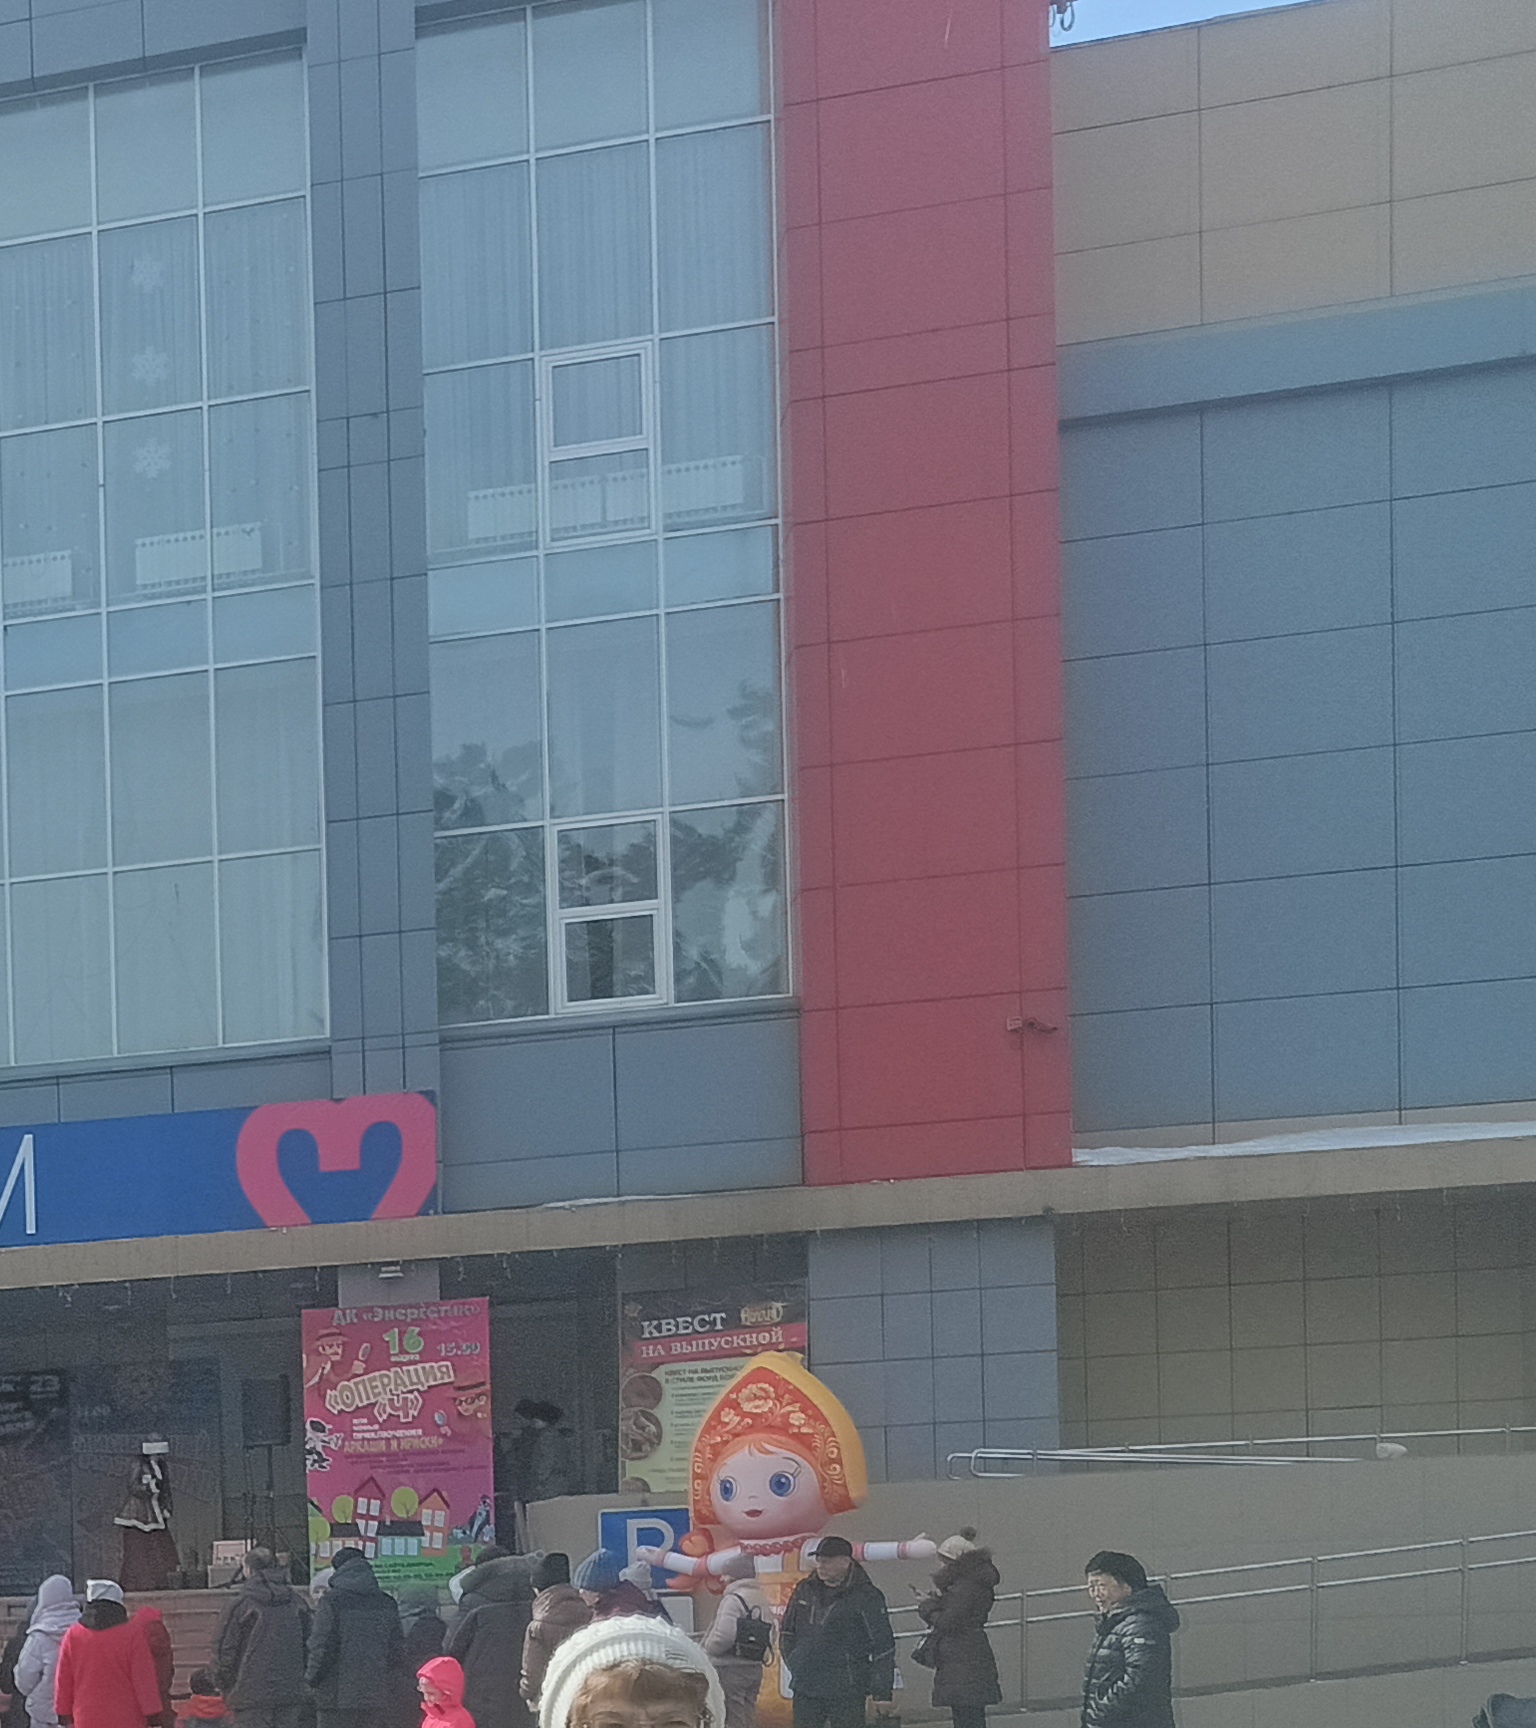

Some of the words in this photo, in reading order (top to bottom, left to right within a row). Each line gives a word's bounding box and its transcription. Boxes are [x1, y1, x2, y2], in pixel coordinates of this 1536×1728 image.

[383, 1326, 425, 1355] 16
[641, 1313, 726, 1338] КВЕСТ
[641, 1344, 665, 1358] НА
[671, 1327, 784, 1355] ВЫПУСКНОЙ
[325, 1361, 455, 1414] «ОПЕРАЦИЯ
[627, 1518, 675, 1568] P
